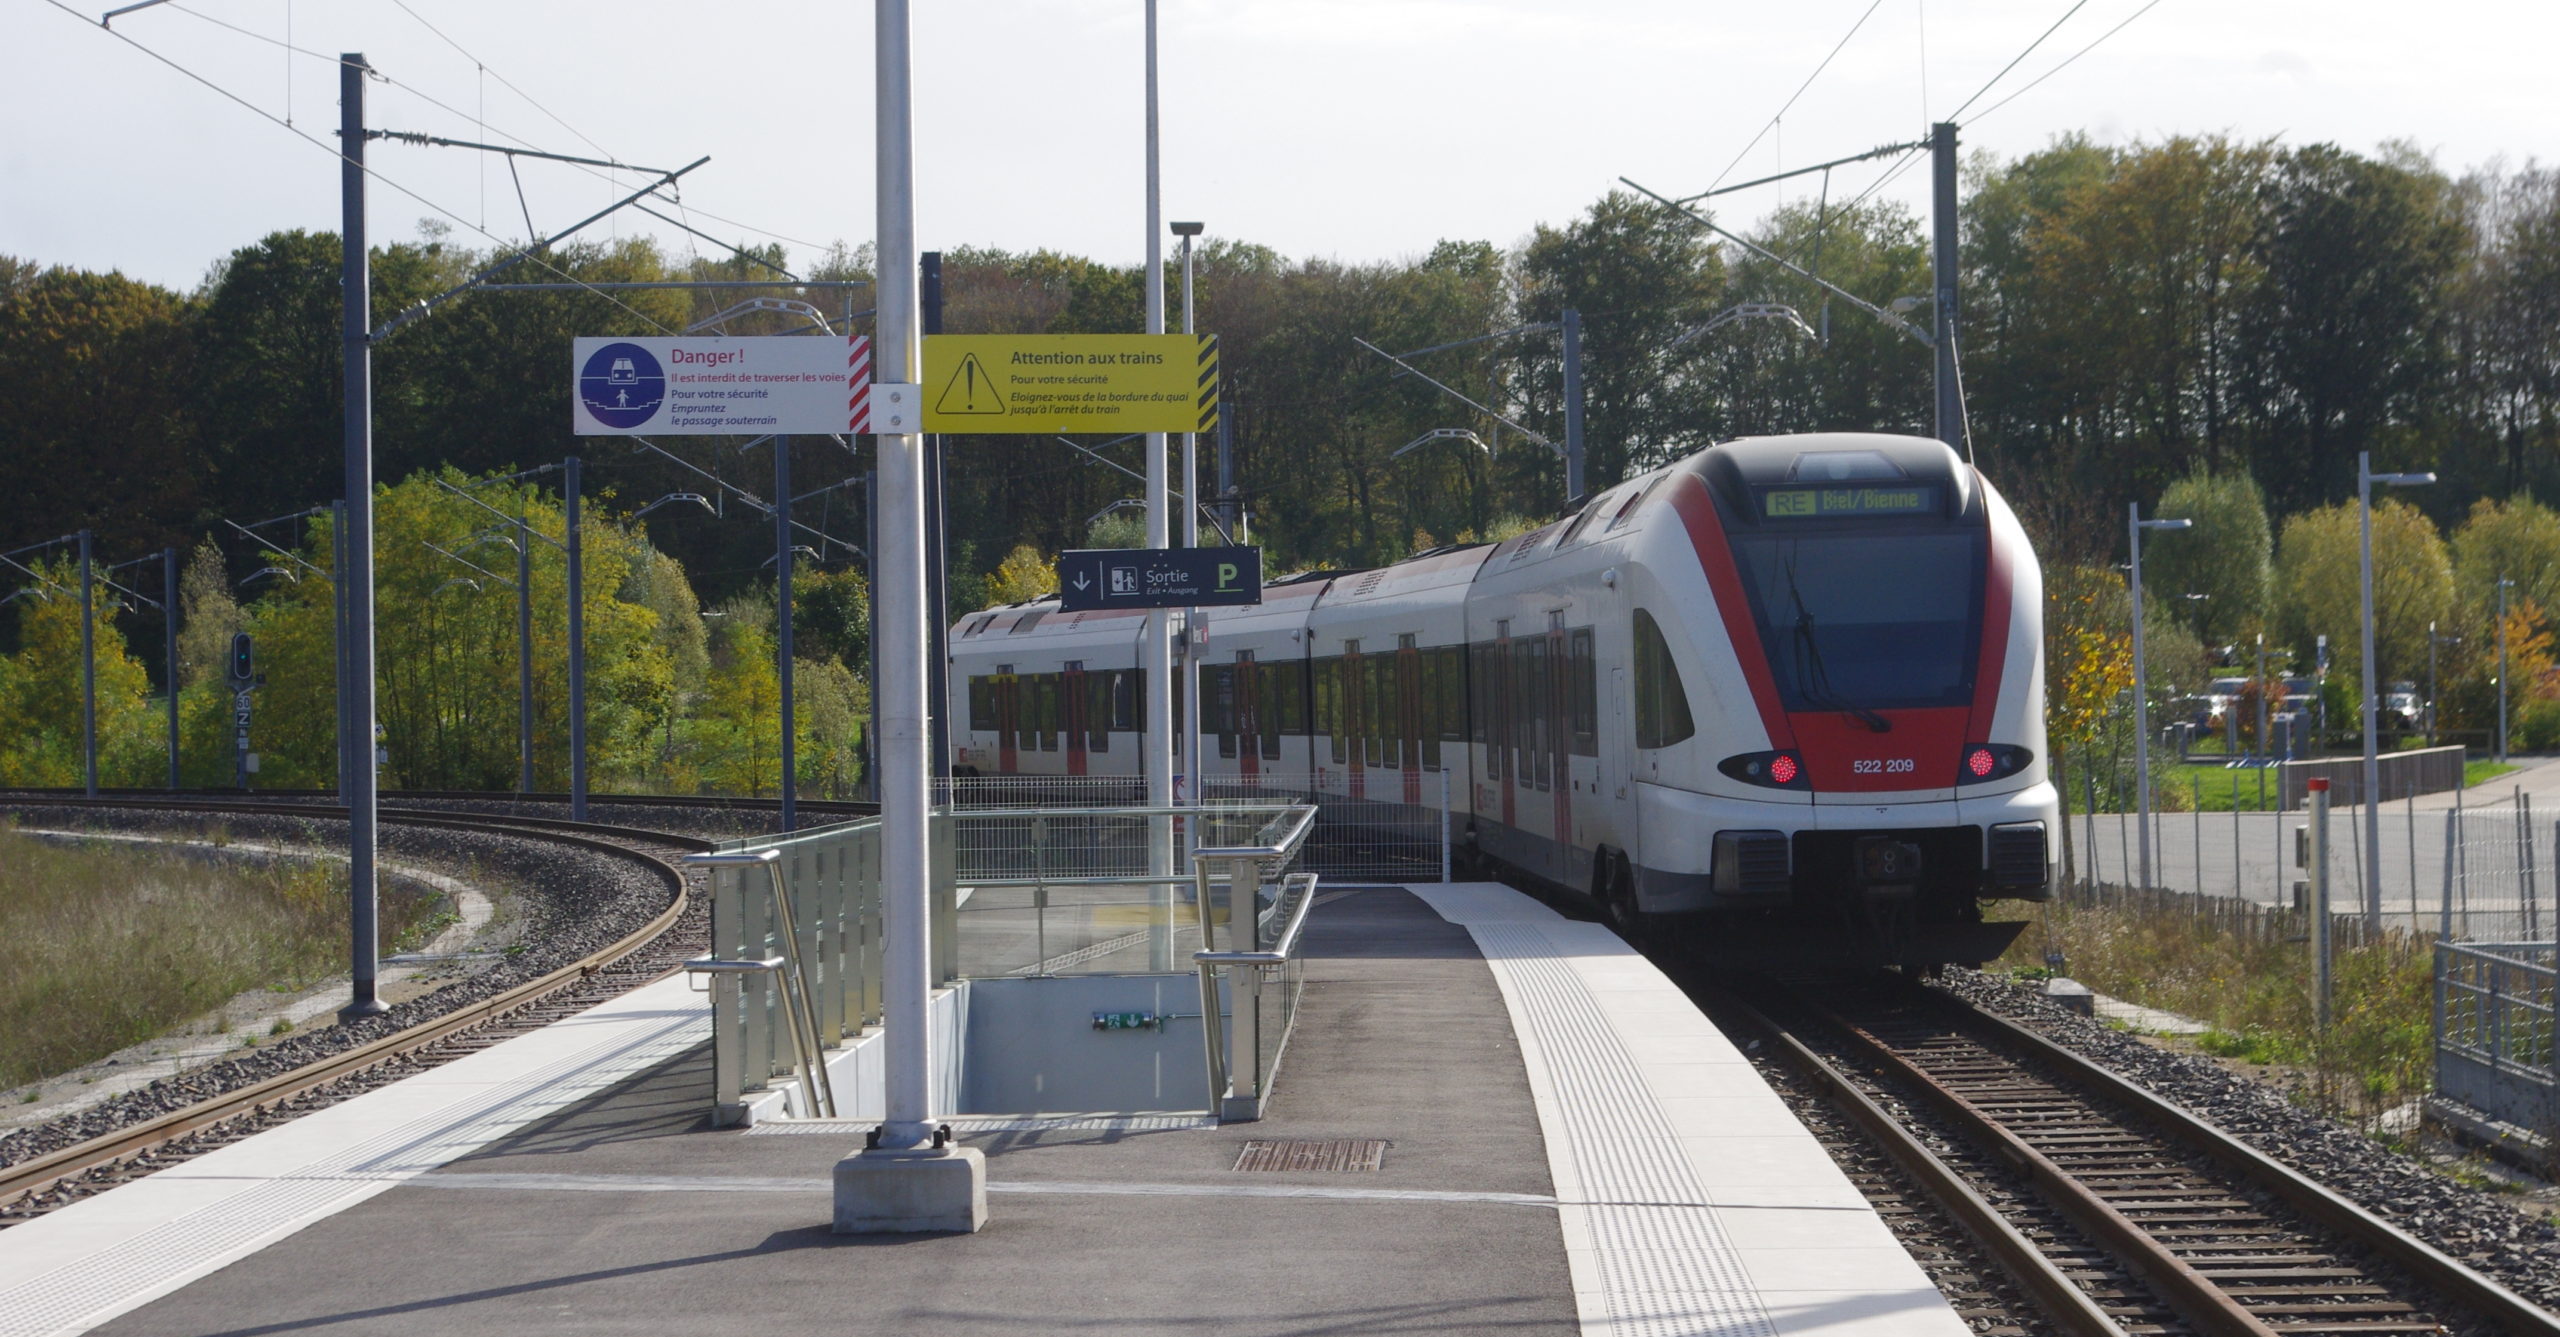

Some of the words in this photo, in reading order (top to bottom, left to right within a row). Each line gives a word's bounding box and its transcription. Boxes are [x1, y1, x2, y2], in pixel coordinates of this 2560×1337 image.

[671, 348, 735, 367] Danger
[739, 348, 745, 364] !
[1010, 351, 1084, 365] Attention
[1087, 354, 1116, 365] aux
[1119, 351, 1163, 365] trains
[671, 373, 678, 383] Il
[680, 375, 696, 383] est
[698, 373, 736, 383] interdit
[738, 373, 752, 383] de
[754, 374, 800, 383] traverser
[802, 373, 817, 382] les
[819, 373, 846, 382] voies
[1010, 375, 1035, 384] Pour
[1037, 375, 1065, 384] votre
[1067, 374, 1109, 385] sécurité
[671, 389, 696, 399] Pour
[698, 389, 725, 399] votre
[727, 388, 769, 399] sécurité
[1010, 391, 1080, 404] Eloignez-vous
[1082, 391, 1095, 402] de
[1097, 391, 1107, 402] la
[1109, 391, 1149, 402] bordure
[1151, 391, 1165, 402] du
[1166, 391, 1189, 404] quai
[671, 403, 726, 416] Empruntez
[1009, 404, 1048, 417] jusqu'à
[1049, 404, 1080, 415] l'arrêt
[1080, 405, 1094, 415] du
[1096, 404, 1120, 415] train
[671, 415, 680, 426] le
[682, 416, 723, 428] passage
[725, 415, 777, 426] souterrain
[1774, 492, 1807, 513] RE
[1146, 569, 1189, 584] Sortie
[1218, 563, 1238, 588] P
[1854, 760, 1882, 773] 522
[1886, 759, 1914, 773] 209
